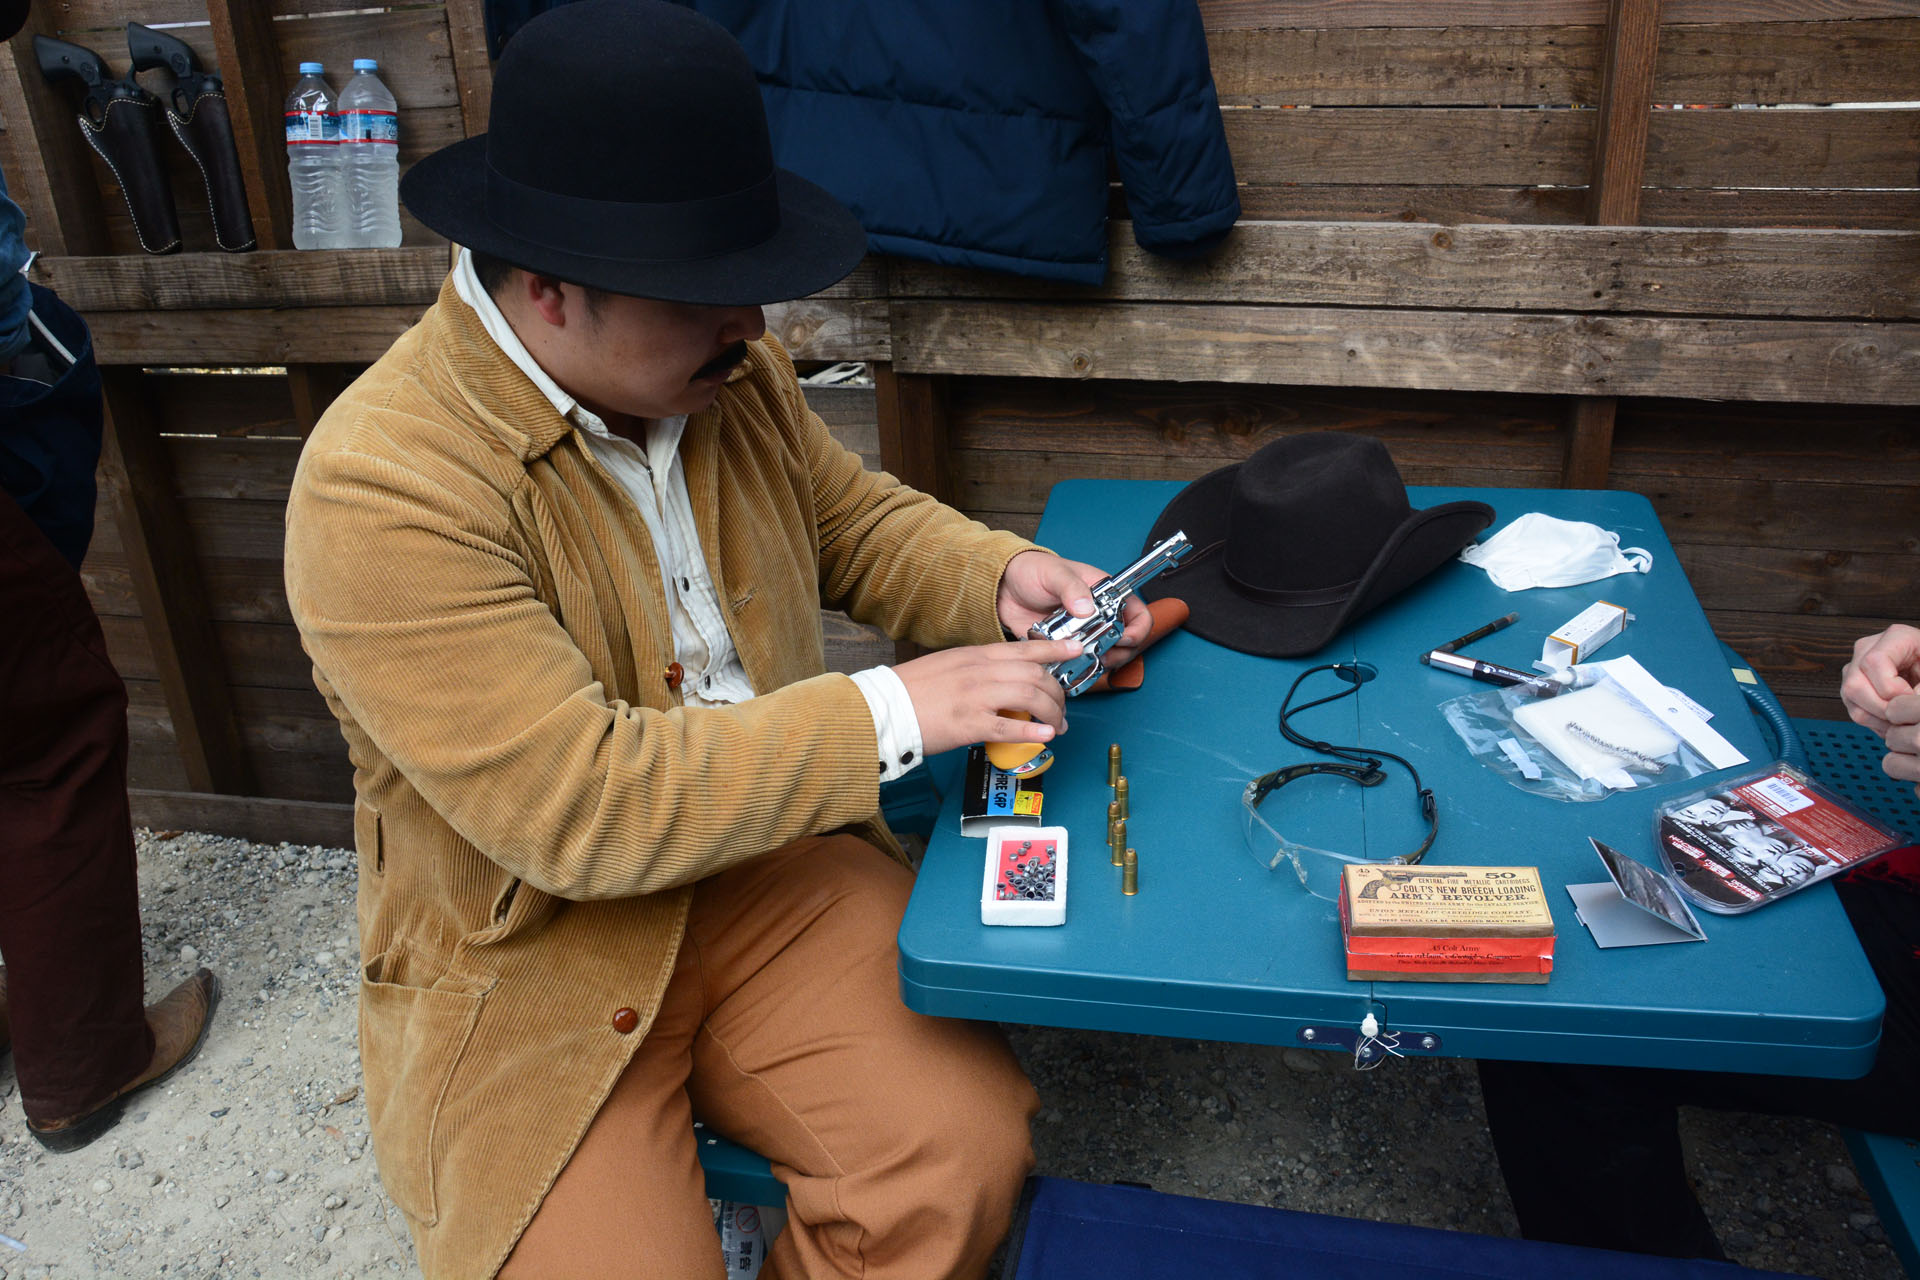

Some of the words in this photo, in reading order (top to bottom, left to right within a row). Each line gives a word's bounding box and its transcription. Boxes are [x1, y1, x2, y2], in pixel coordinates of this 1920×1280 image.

[994, 773, 1009, 791] FIRE
[993, 792, 1008, 809] CAP
[1403, 885, 1434, 893] COLT'S
[1436, 886, 1458, 894] NEW
[1461, 886, 1494, 894] BREECH
[1497, 885, 1537, 895] LOADING
